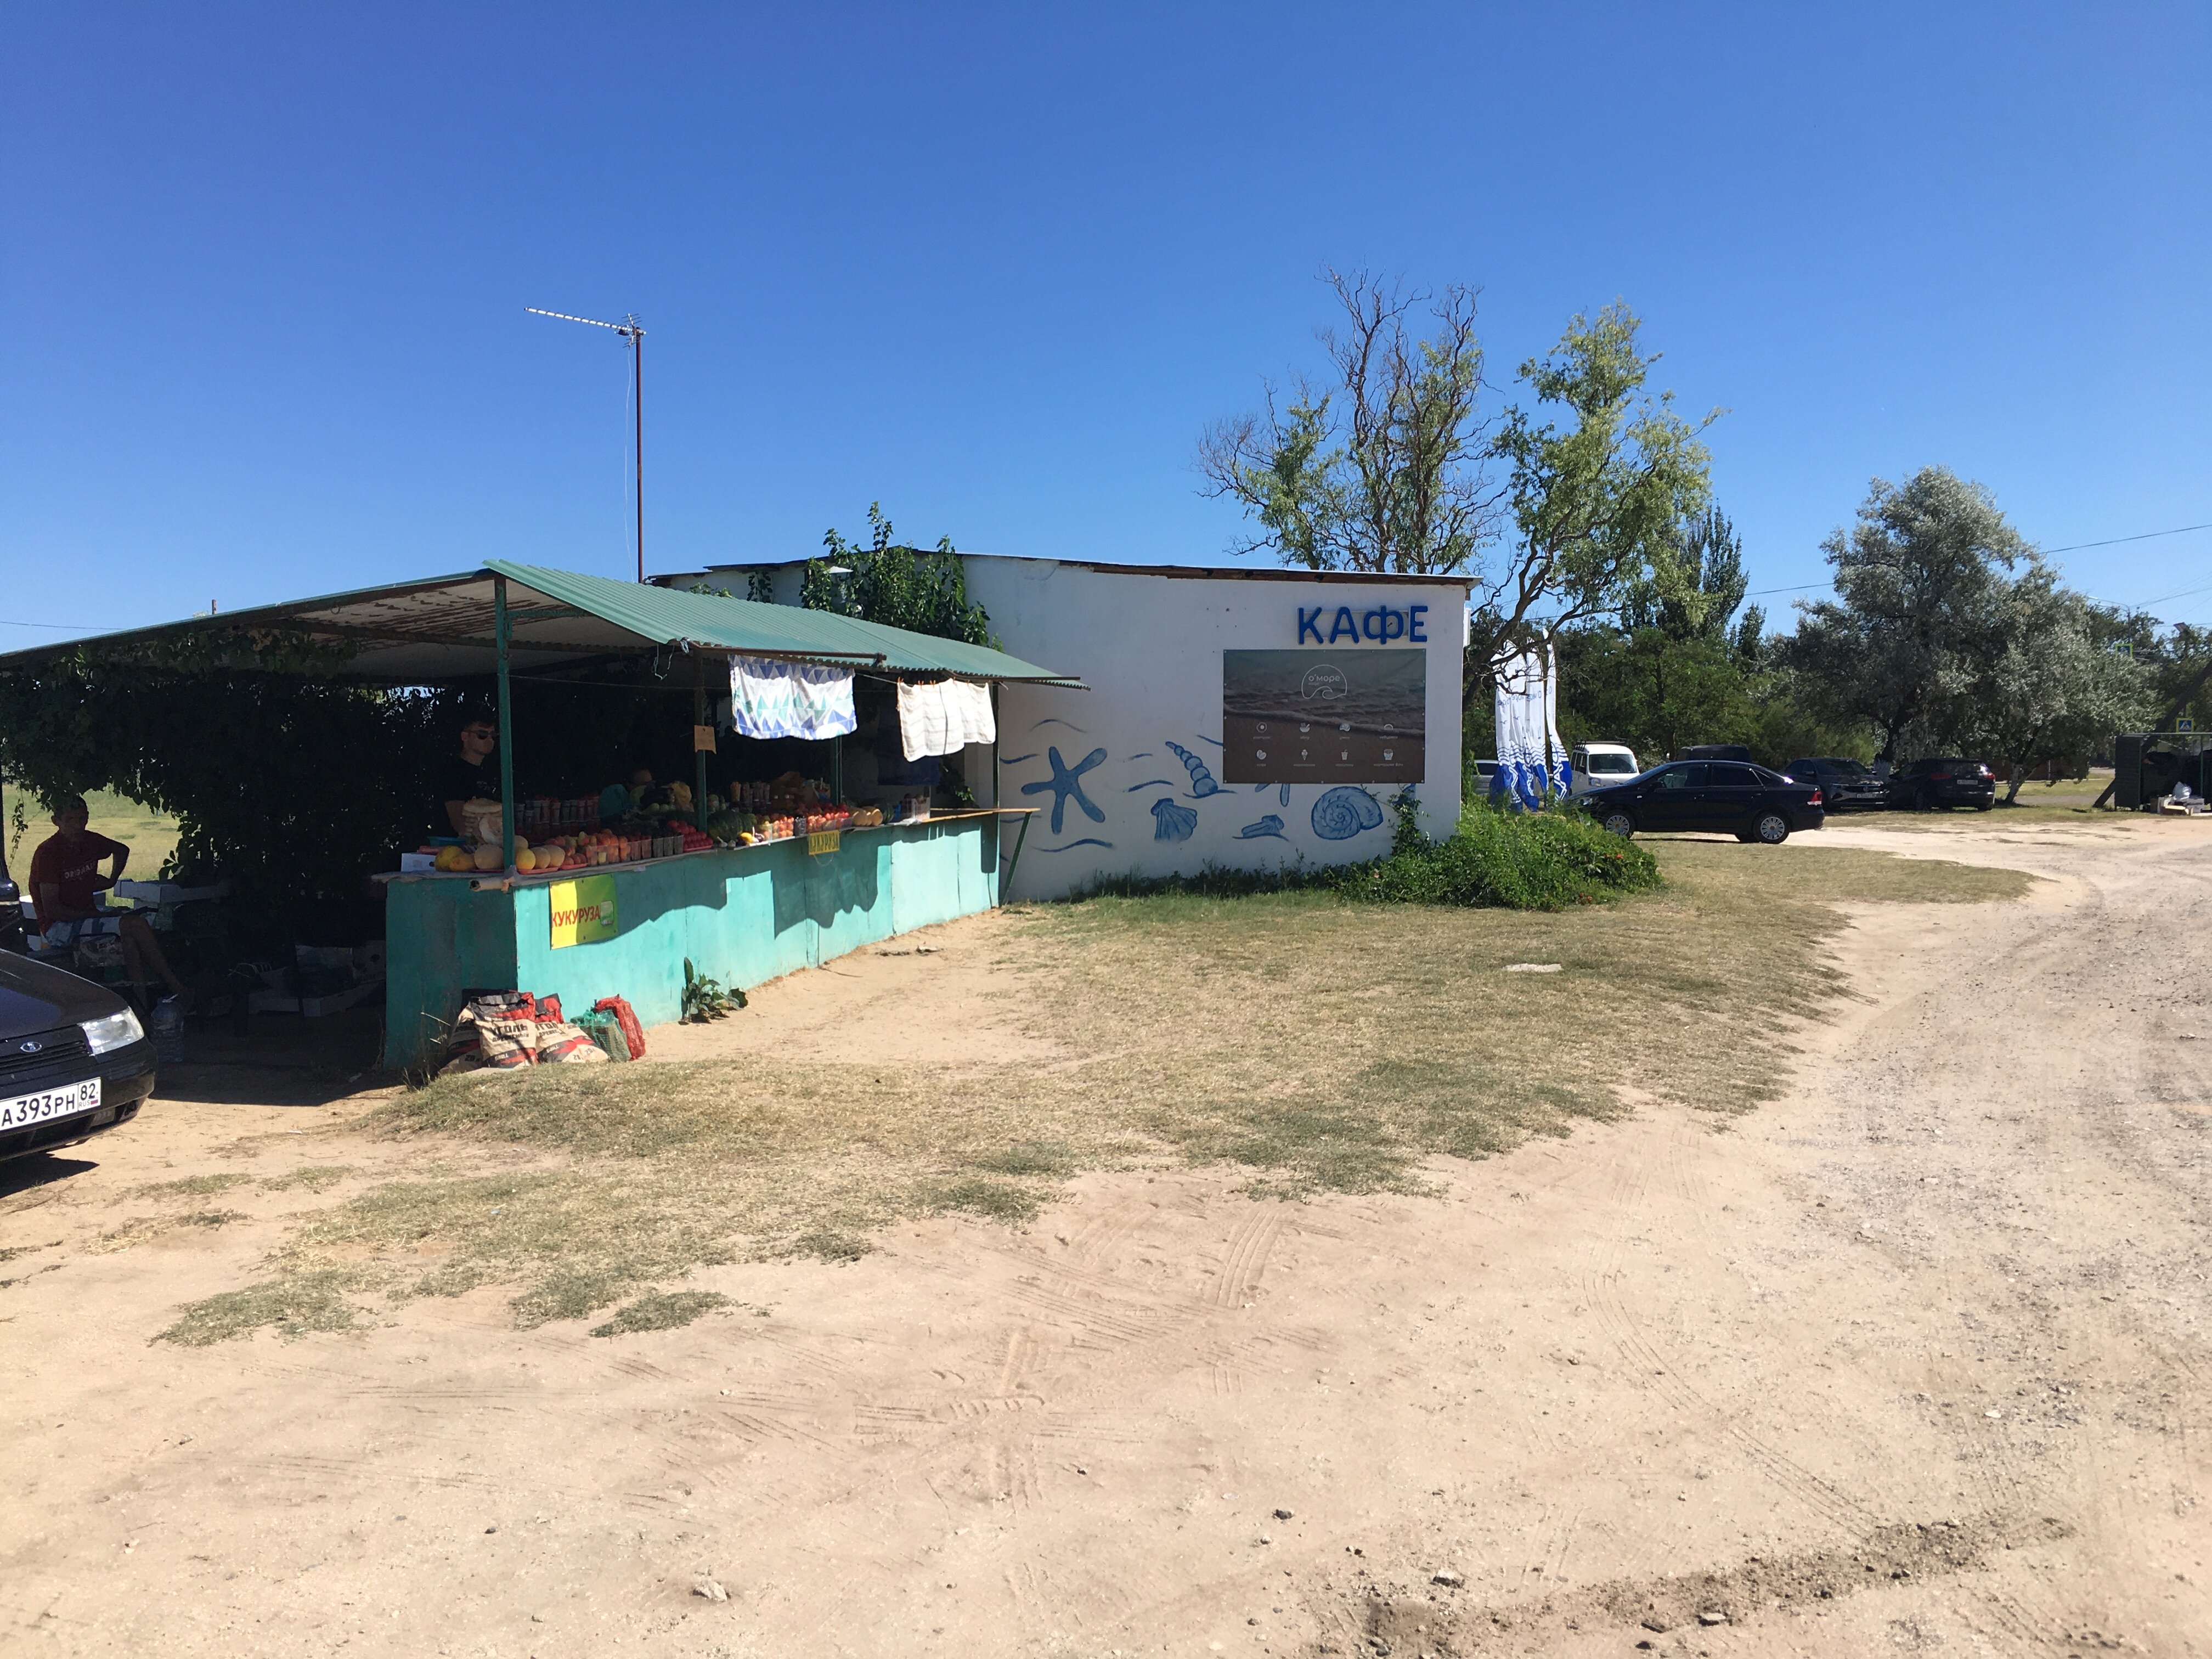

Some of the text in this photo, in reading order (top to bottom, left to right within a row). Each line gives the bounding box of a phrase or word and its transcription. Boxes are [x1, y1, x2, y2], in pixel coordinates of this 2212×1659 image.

[1297, 605, 1428, 645] КАФЕ
[1308, 674, 1340, 683] о'море
[551, 905, 600, 928] КУКУРУЗА
[489, 1024, 528, 1036] УГОЛЬ
[2, 1083, 95, 1126] А393РН 82
